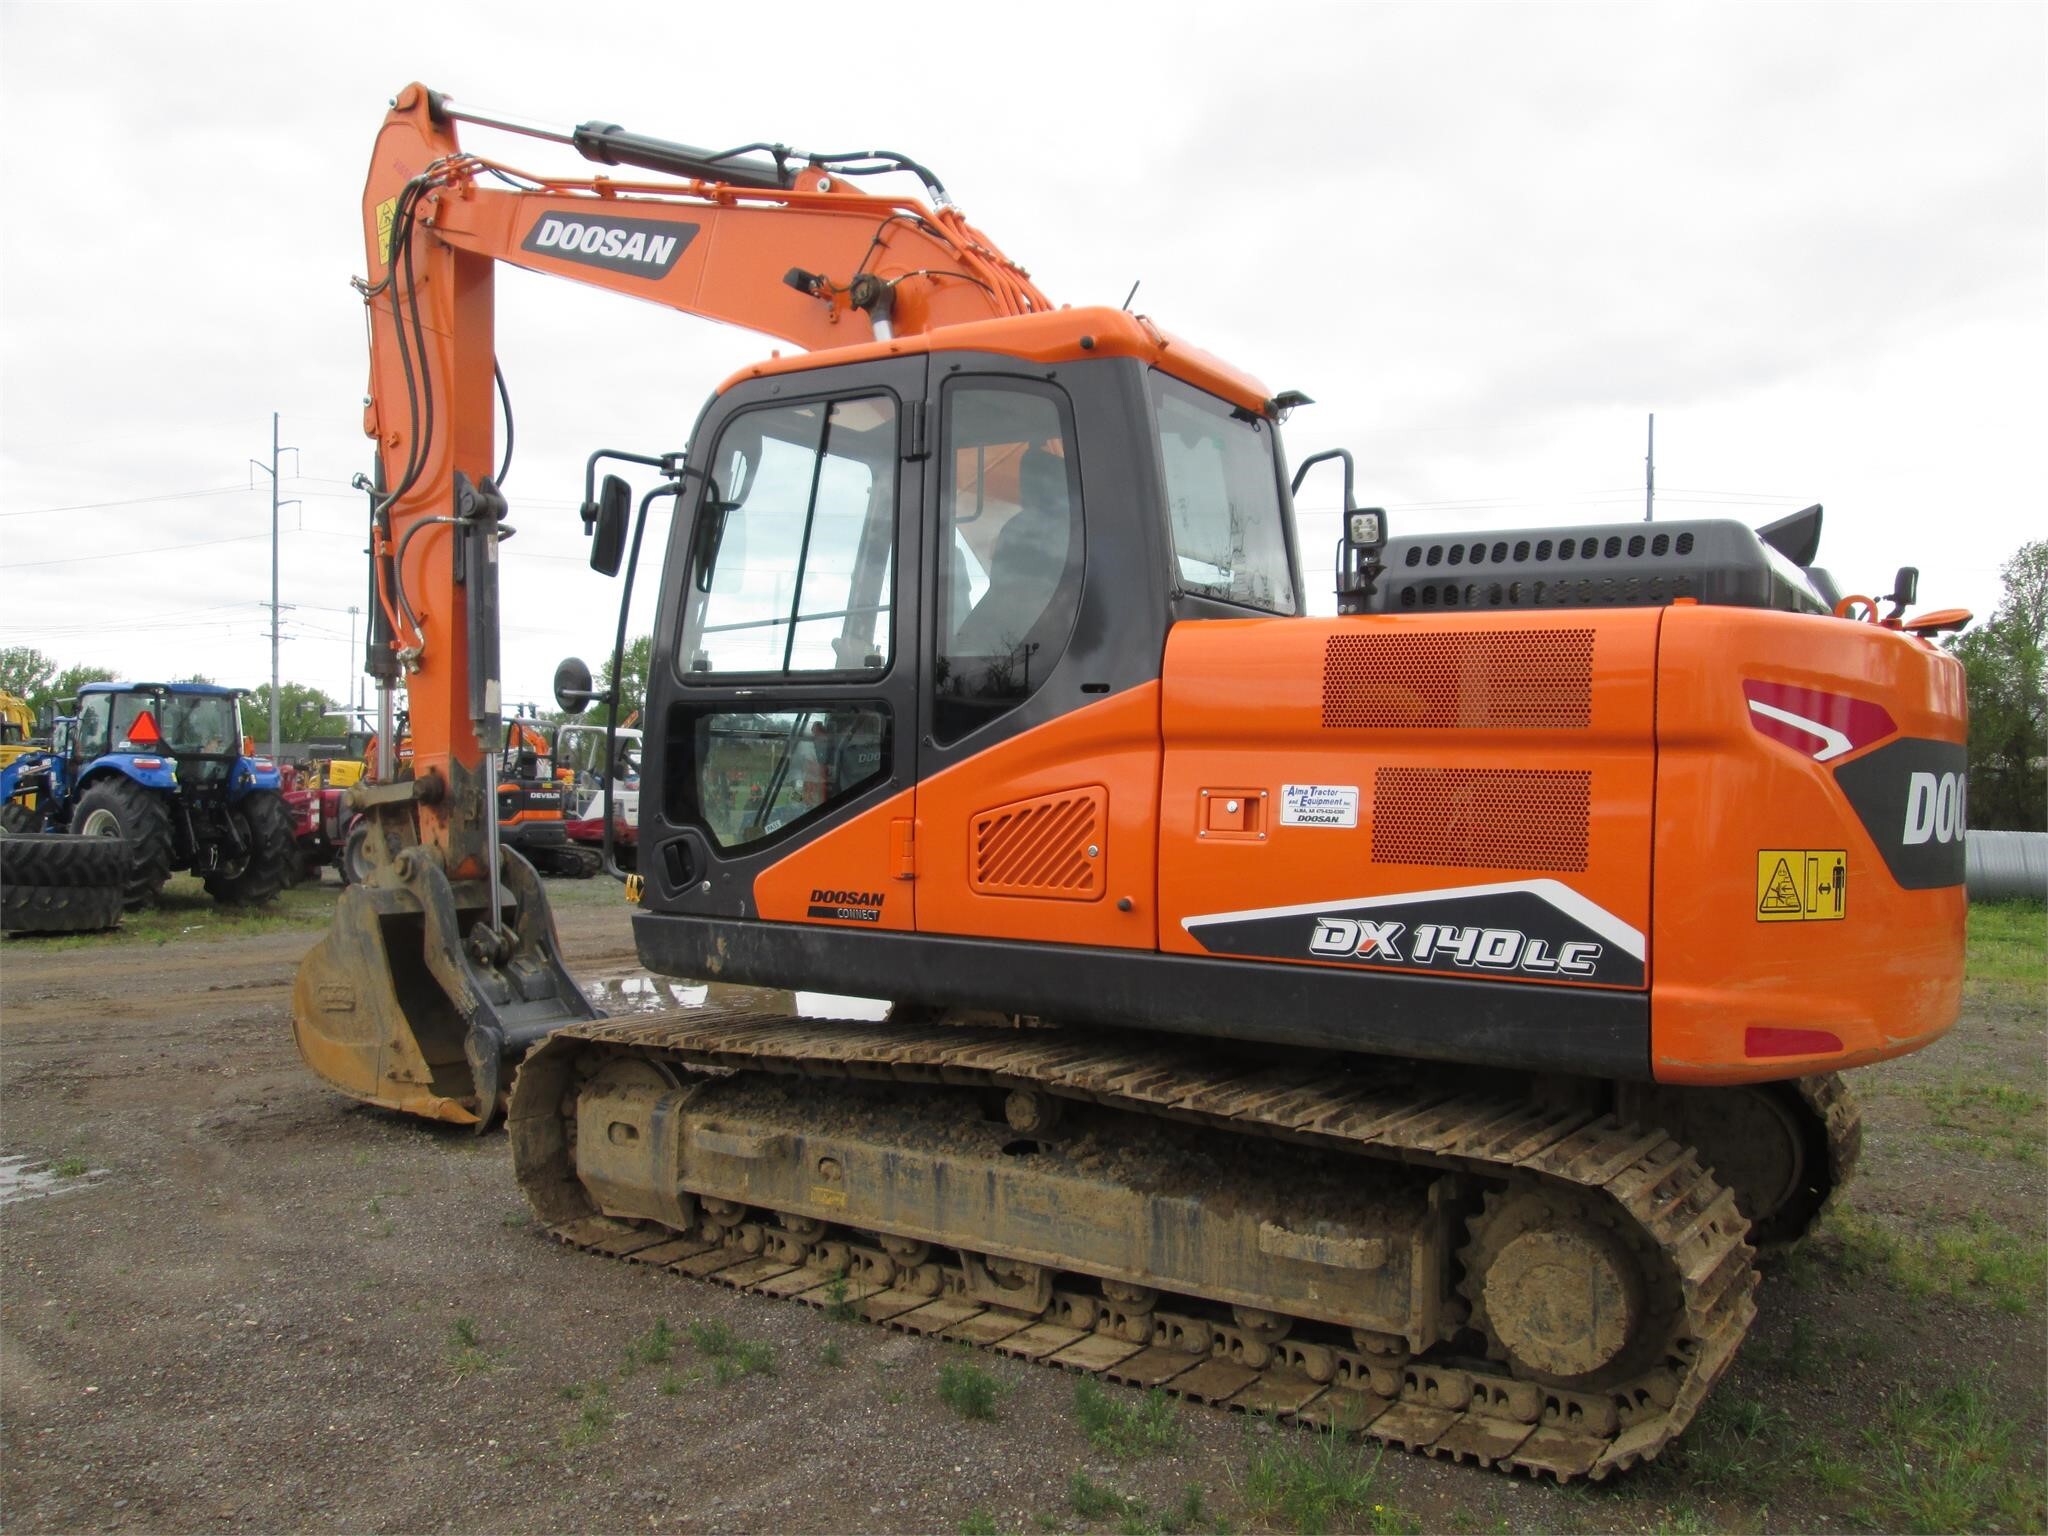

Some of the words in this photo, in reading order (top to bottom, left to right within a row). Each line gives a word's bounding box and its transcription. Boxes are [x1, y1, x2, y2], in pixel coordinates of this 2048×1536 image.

[536, 219, 677, 265] DOOSAN
[1288, 786, 1308, 796] Alma
[1310, 786, 1338, 797] Tractor
[1300, 796, 1342, 806] Equipment
[1297, 815, 1340, 823] DOOSAN
[810, 889, 885, 906] DOOSAN
[837, 908, 878, 920] CONNECT
[1310, 918, 1406, 961] DX
